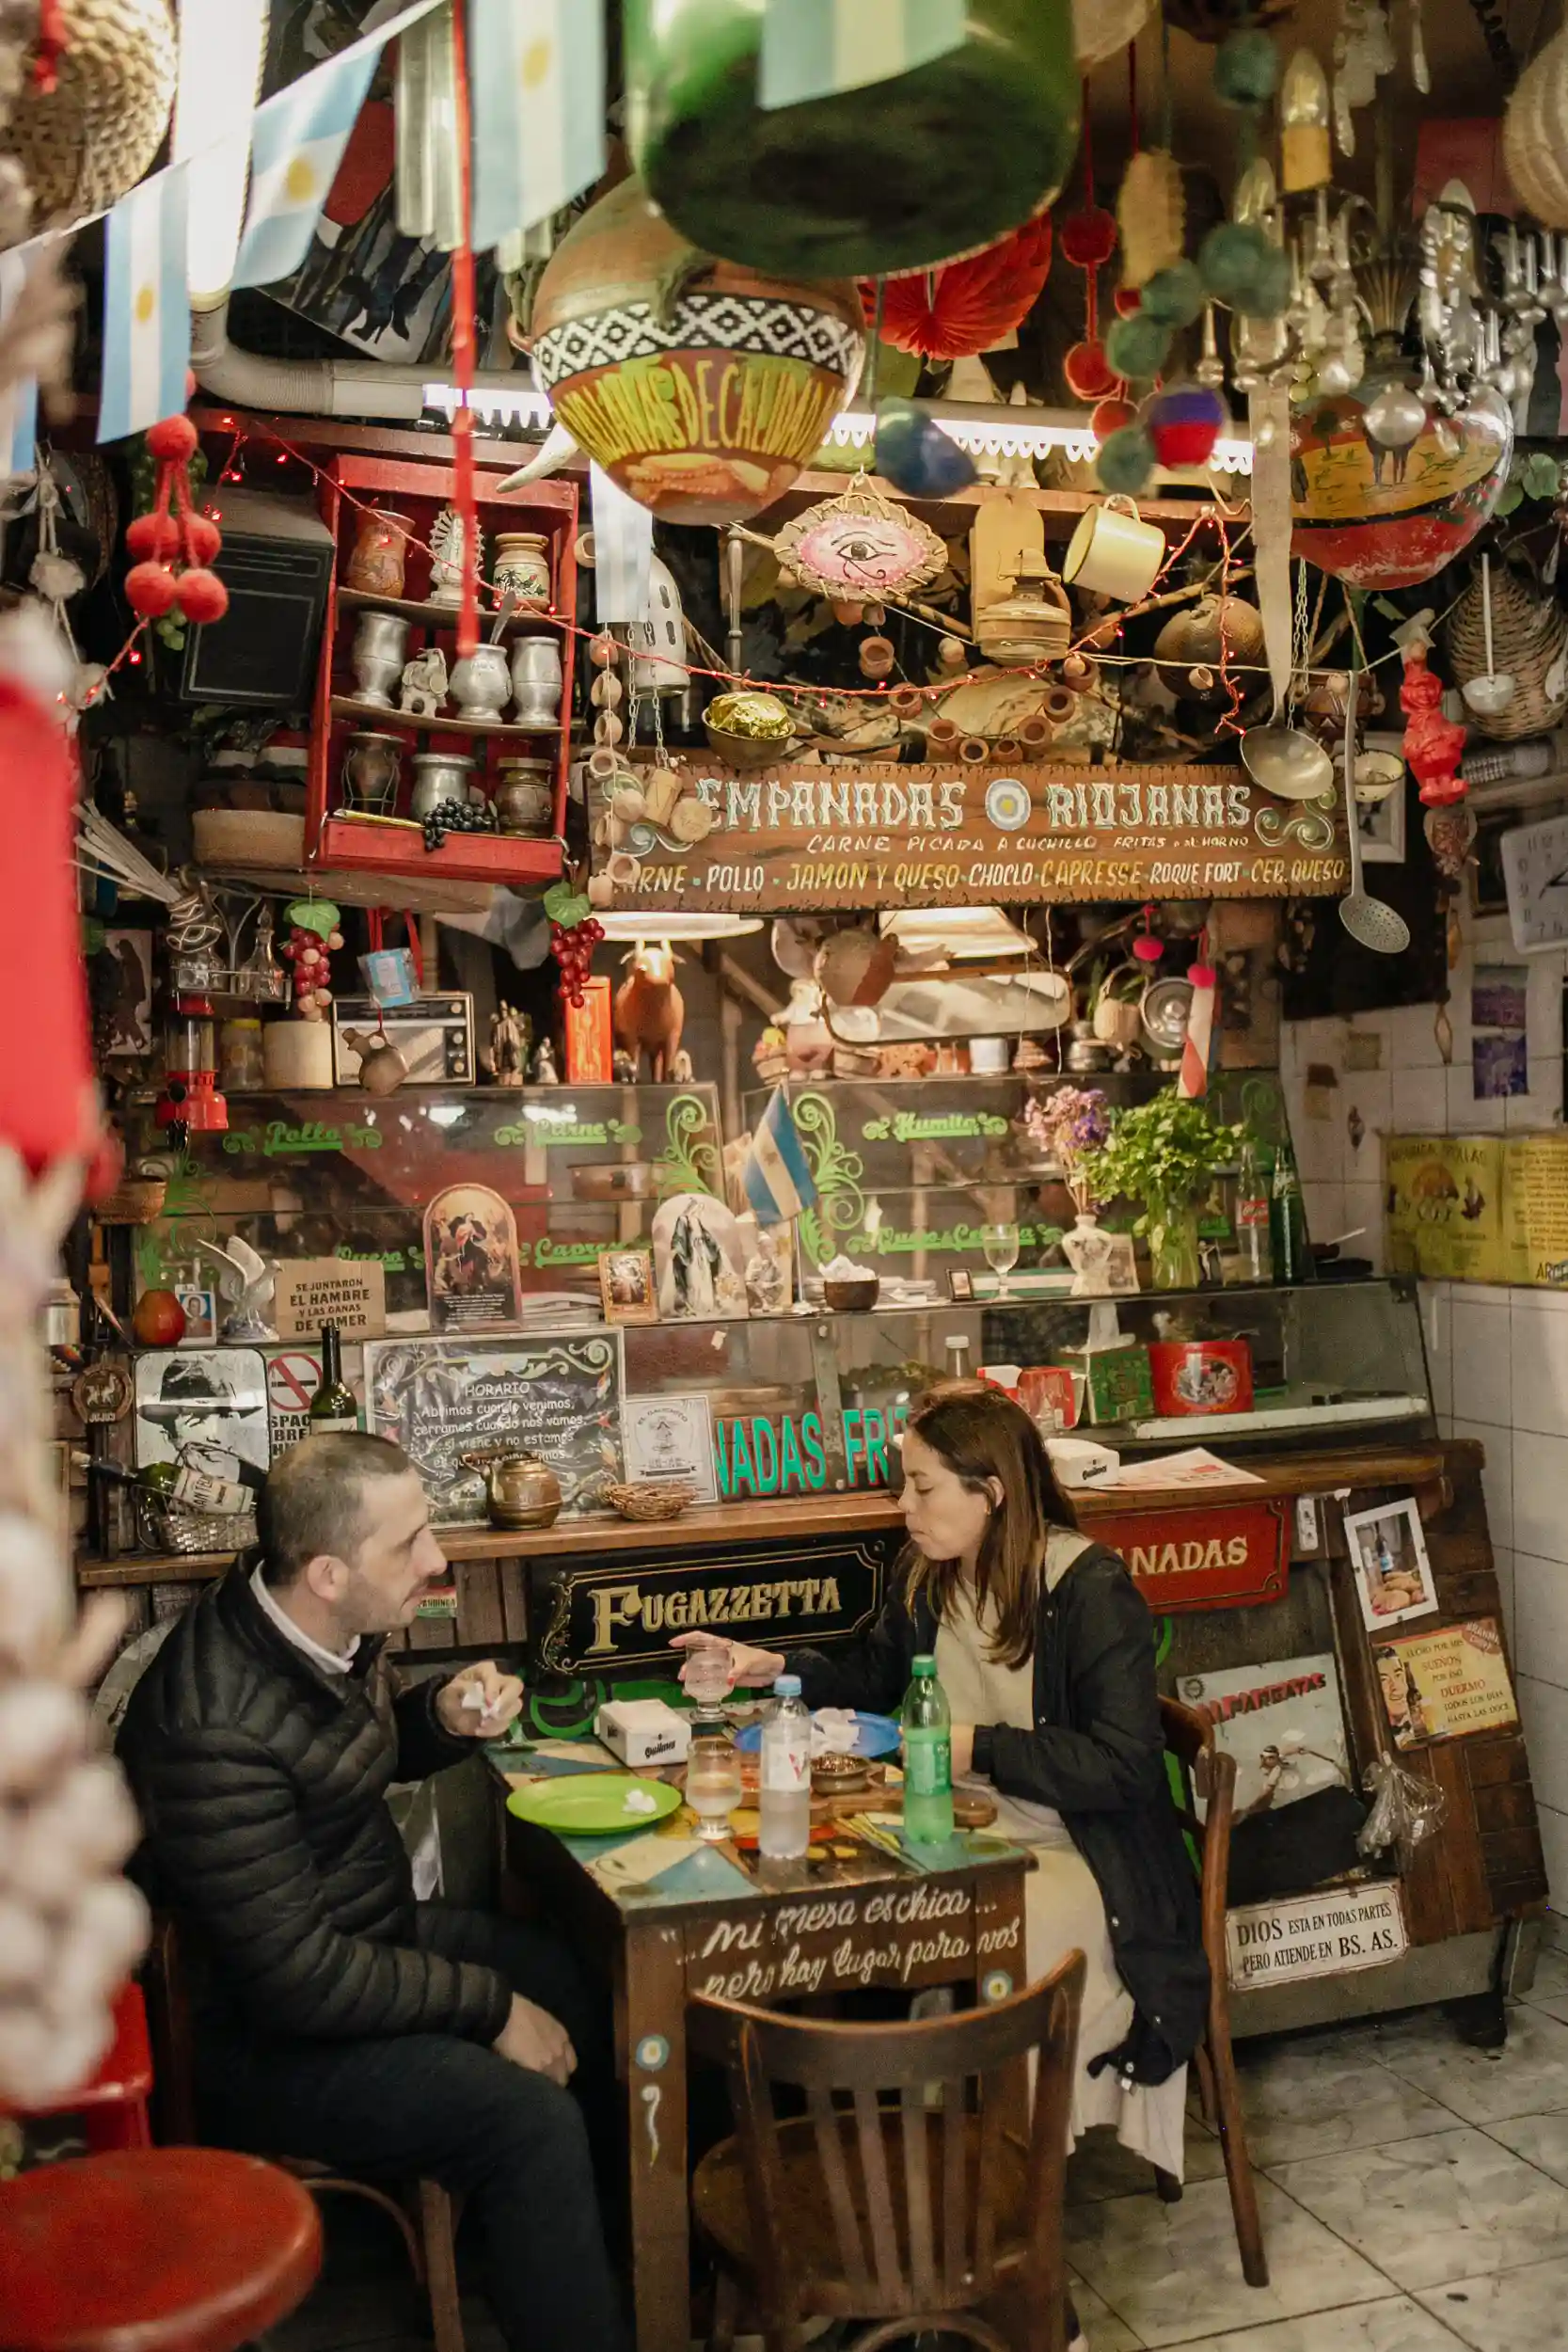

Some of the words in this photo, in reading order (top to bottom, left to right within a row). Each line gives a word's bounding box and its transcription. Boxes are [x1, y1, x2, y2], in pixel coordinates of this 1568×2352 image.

[696, 778, 968, 831] EMPANADAS
[1046, 783, 1251, 830] RIOJANAS
[807, 834, 891, 853] CARNE
[907, 835, 985, 851] PICADA
[997, 836, 1008, 850] A
[1016, 835, 1098, 850] CUCHILLO
[621, 866, 688, 894] RNE
[706, 865, 765, 892] POLLO
[787, 862, 869, 891] JAMON
[877, 864, 889, 890] Y
[895, 863, 961, 892] QUESO
[969, 862, 1034, 888] CHOCLO
[1040, 859, 1144, 888] CAPRESSE
[1149, 862, 1201, 885] ROQUE
[1205, 862, 1243, 883] FORT
[1291, 859, 1345, 883] QUESO
[291, 1295, 307, 1307] EL
[310, 1289, 371, 1305] HAMBRE
[295, 1283, 309, 1292] SE
[309, 1278, 363, 1292] JUNTARON
[295, 1320, 313, 1331] DE
[318, 1314, 367, 1329] COMER
[309, 1306, 325, 1316] LAS
[328, 1303, 361, 1314] GANAS
[466, 1381, 531, 1397] HORARIO
[1115, 1534, 1249, 1576] NADAS
[584, 1576, 843, 1655] FUGAZZETTA
[1440, 1678, 1485, 1698] DUERMO
[1237, 1918, 1284, 1947] DIOS
[1289, 1919, 1311, 1935] ESTA
[1312, 1915, 1325, 1930] EN
[1327, 1909, 1357, 1928] TODAS
[1357, 1902, 1392, 1921] PARTES
[779, 1943, 827, 1992] hay
[902, 1931, 971, 1983] para
[976, 1916, 1021, 1954] vos
[1243, 1952, 1271, 1973] PERO
[1274, 1943, 1318, 1968] ATIENDE
[1319, 1941, 1333, 1959] EN
[1338, 1934, 1367, 1958] BS.
[1371, 1929, 1399, 1951] AS.
